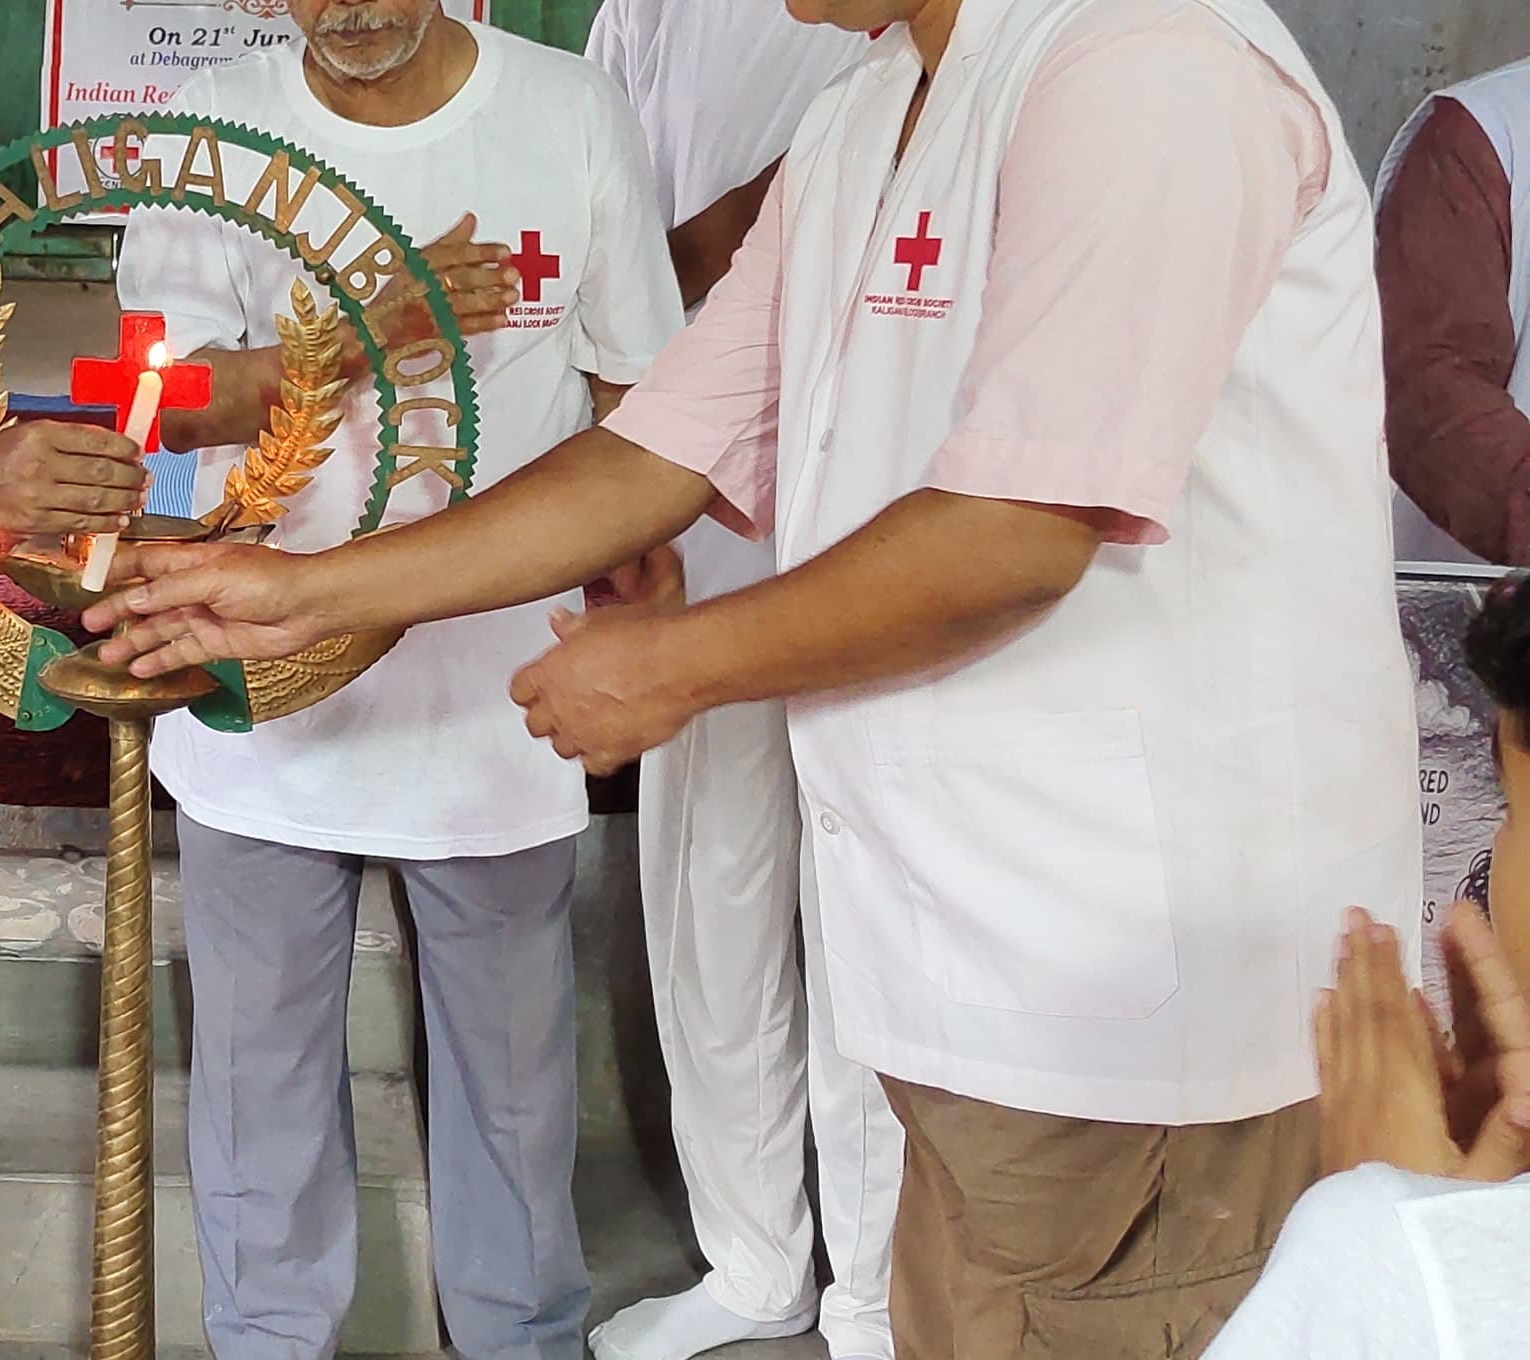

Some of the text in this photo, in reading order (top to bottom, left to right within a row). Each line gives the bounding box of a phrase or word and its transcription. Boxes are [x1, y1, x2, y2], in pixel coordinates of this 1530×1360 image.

[148, 26, 183, 46] On
[190, 25, 236, 46] 21st
[129, 51, 146, 66] at
[65, 82, 181, 105] Indian Re
